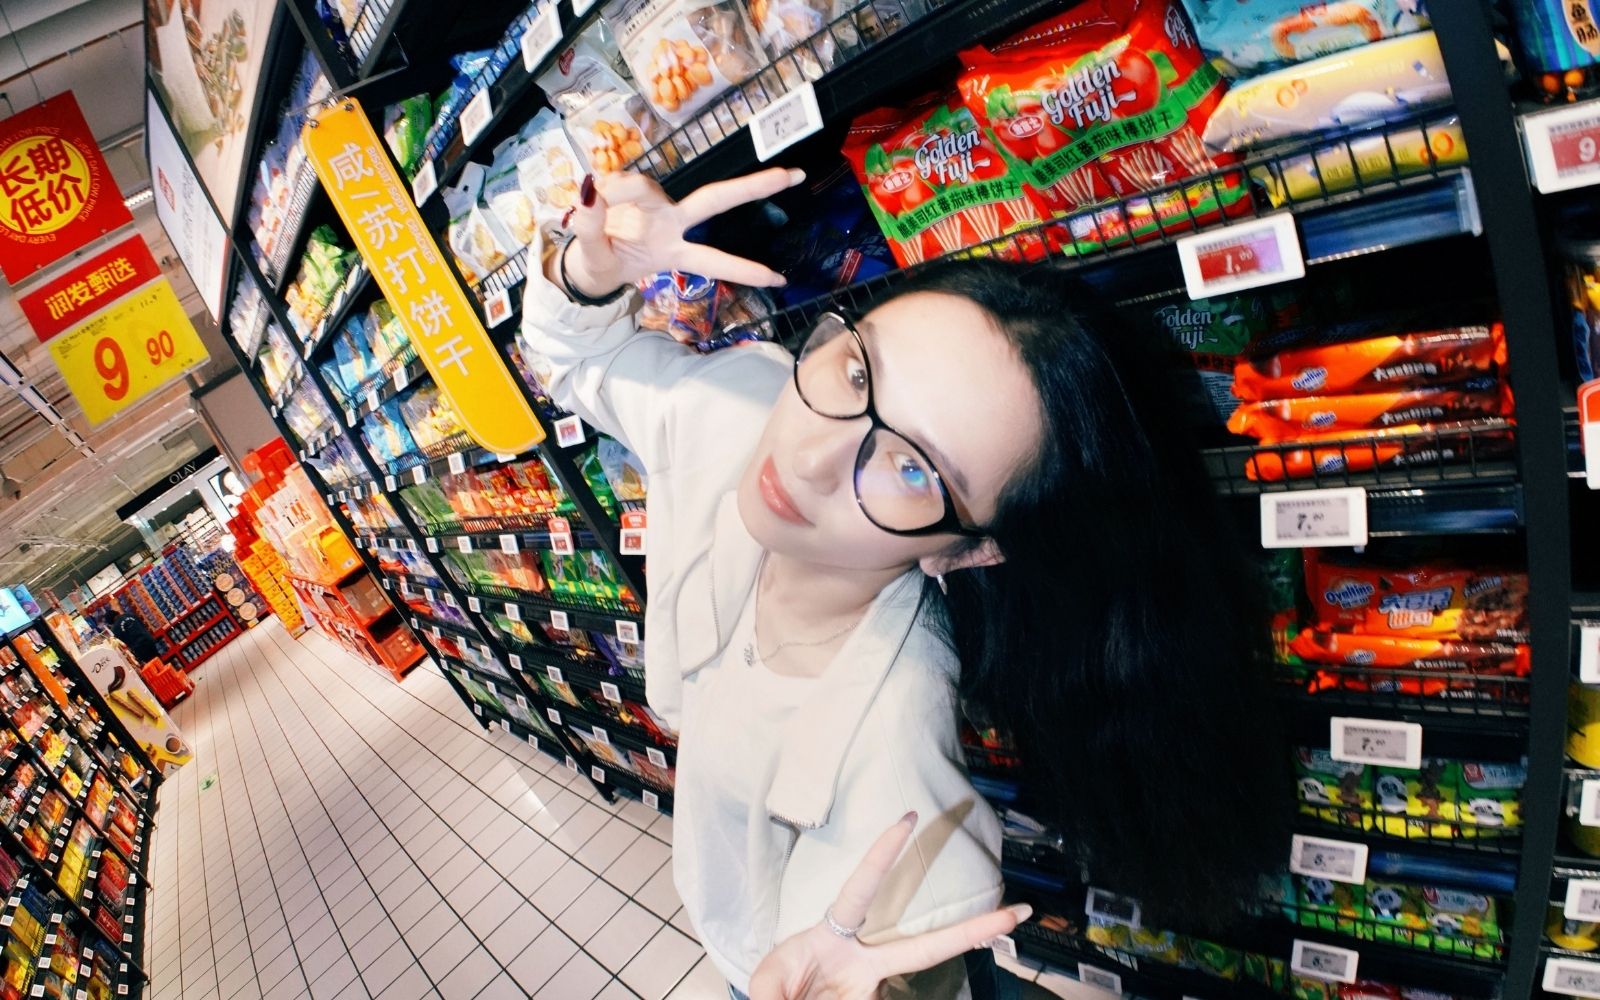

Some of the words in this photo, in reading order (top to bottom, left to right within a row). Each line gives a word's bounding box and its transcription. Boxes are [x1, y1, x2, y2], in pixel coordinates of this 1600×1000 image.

[1042, 58, 1121, 124] Golden
[1067, 91, 1136, 129] Fuji
[0, 136, 71, 197] 长期
[913, 128, 981, 180] Golden
[935, 156, 990, 185] Fuji
[11, 173, 85, 233] 低价
[405, 217, 437, 265] CRACKER
[46, 257, 137, 320] 润发甄选
[94, 337, 129, 400] 9
[146, 330, 174, 365] 90
[169, 461, 196, 484] OLAY
[1325, 582, 1373, 603] Ovaltine
